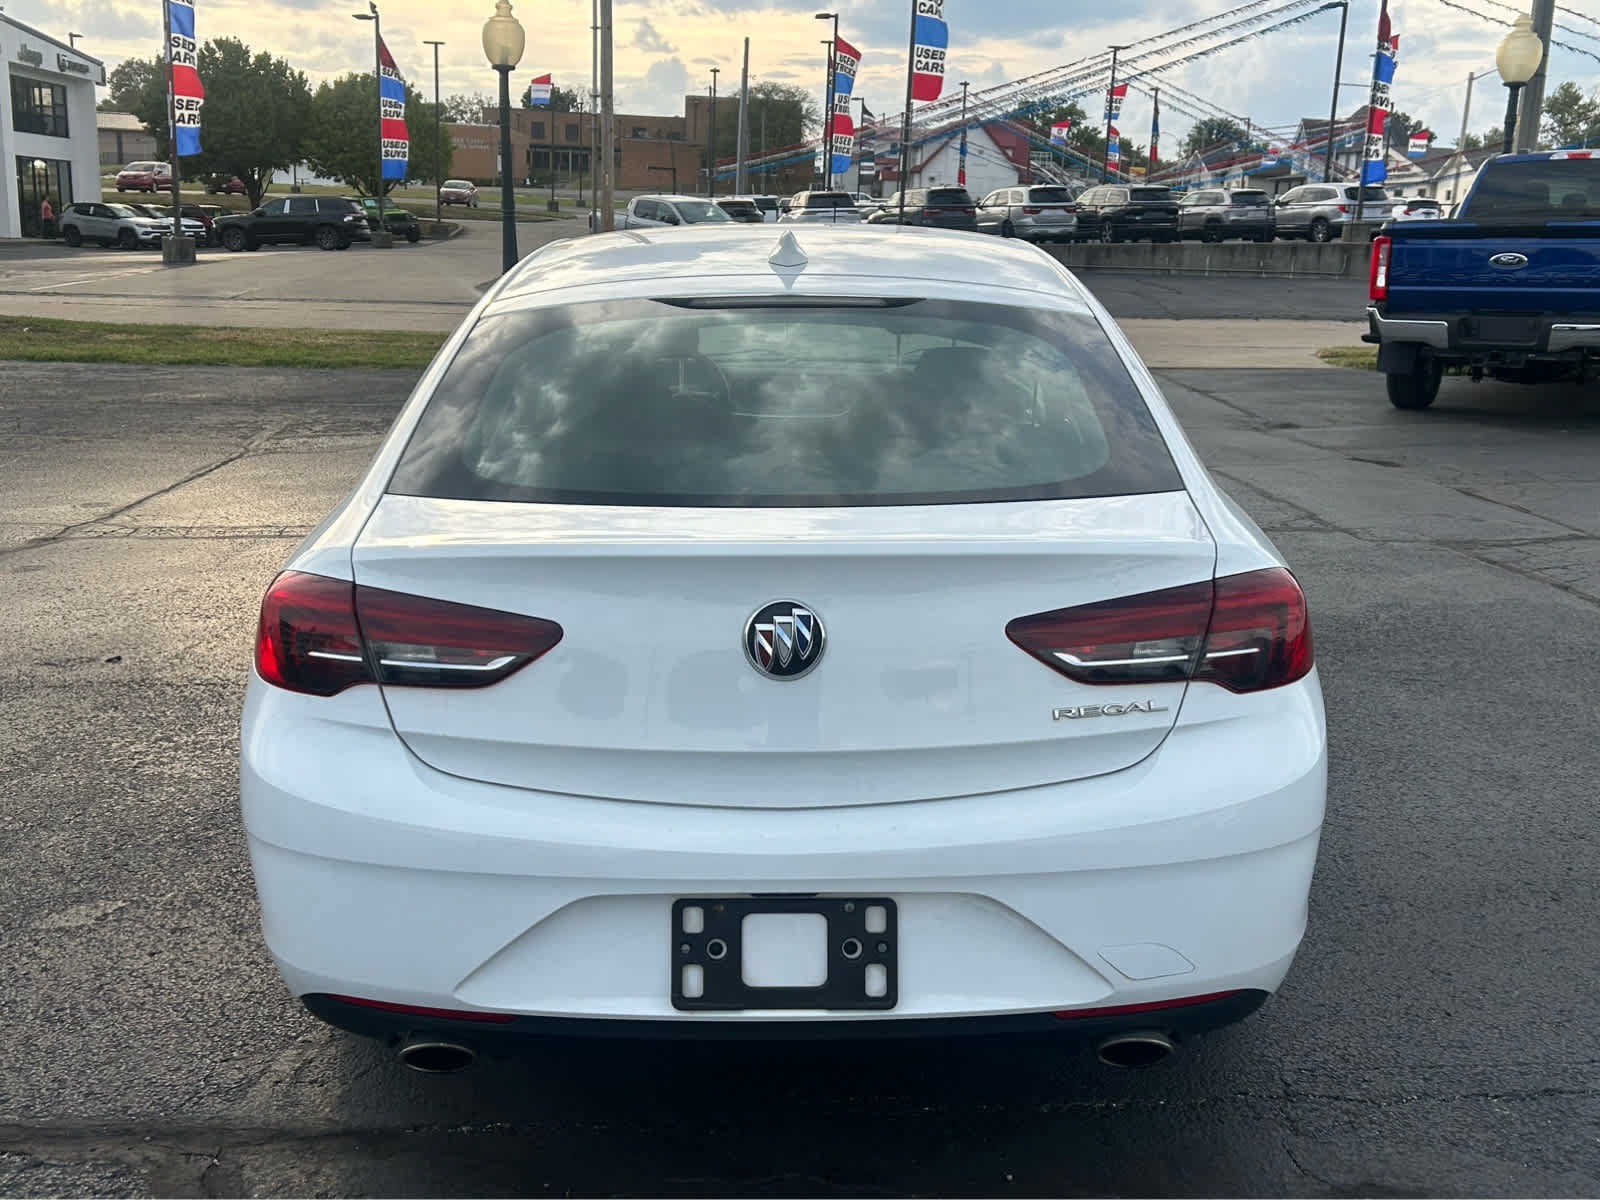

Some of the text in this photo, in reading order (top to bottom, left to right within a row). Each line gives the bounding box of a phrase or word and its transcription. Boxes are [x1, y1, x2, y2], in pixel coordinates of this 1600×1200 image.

[170, 36, 196, 52] SED
[916, 47, 946, 60] USED
[915, 60, 945, 73] CARS
[382, 141, 407, 149] USED
[1052, 700, 1168, 720] REGAL
